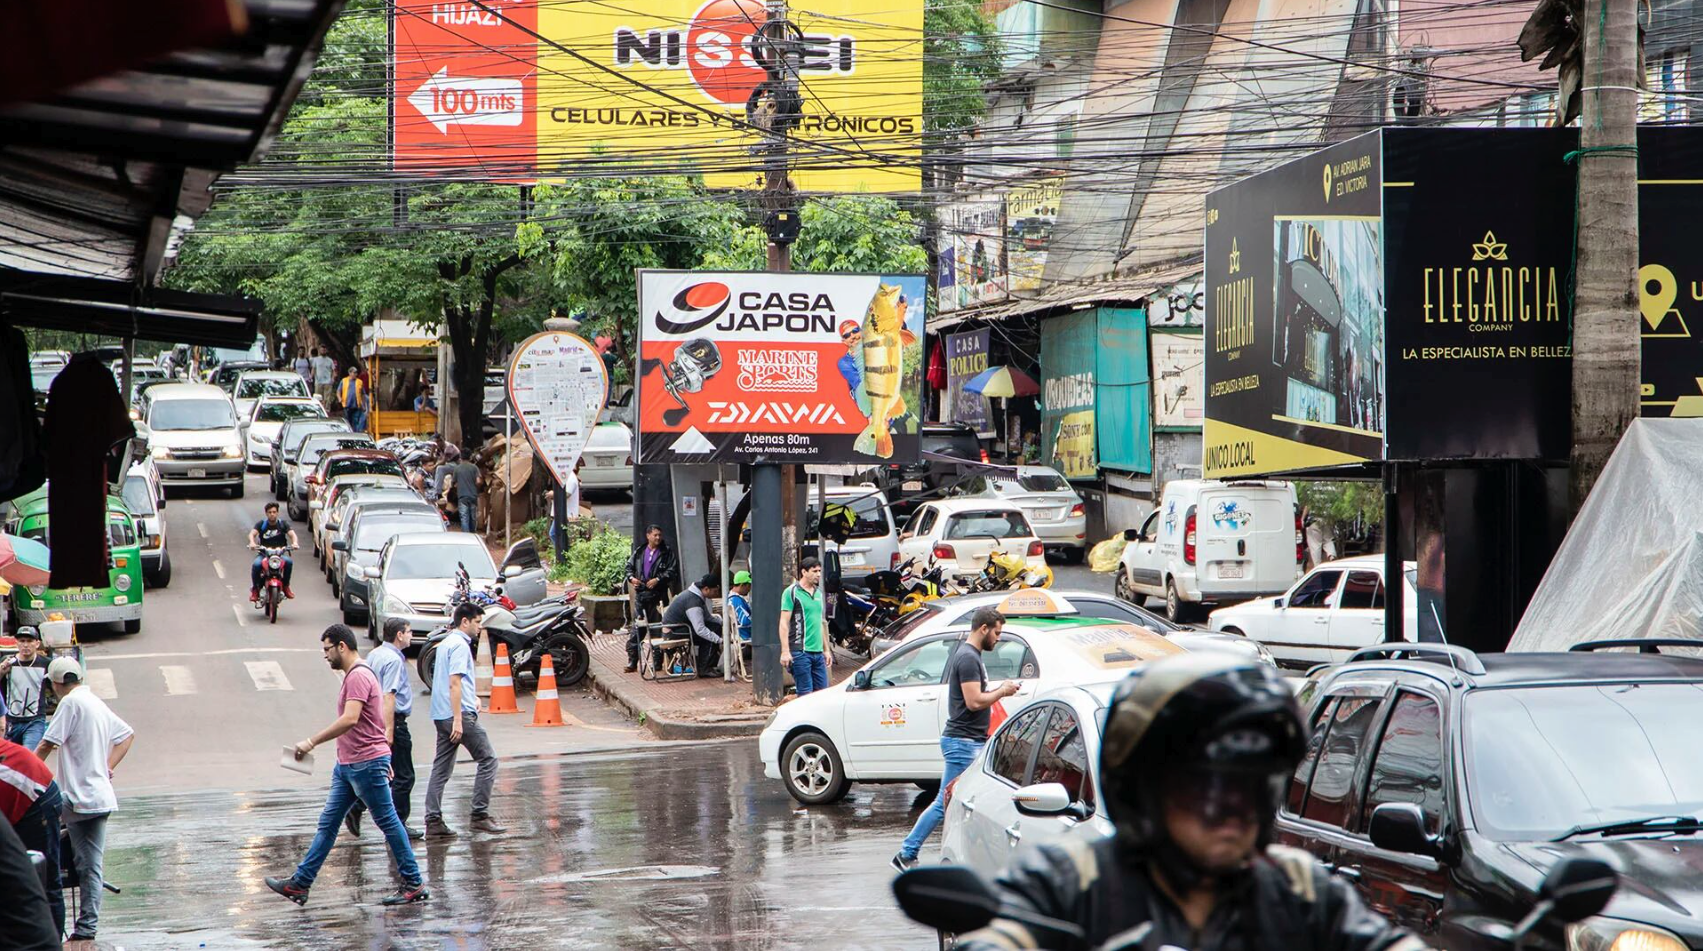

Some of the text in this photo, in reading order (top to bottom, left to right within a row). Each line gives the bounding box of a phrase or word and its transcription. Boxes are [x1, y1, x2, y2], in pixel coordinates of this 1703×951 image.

[432, 4, 502, 26] HIJAZI
[430, 87, 516, 115] 100 mts
[550, 107, 699, 127] CELULARES
[739, 292, 835, 311] CASA
[1423, 266, 1560, 323] ELEGANCIA
[716, 313, 836, 333] JAPON
[1468, 323, 1514, 332] COMPANY
[956, 335, 981, 353] CASA
[1402, 346, 1573, 360] LA ESPECIALISTA EN BELLEZ
[738, 350, 818, 365] MARINE
[950, 352, 988, 377] POLICE
[1045, 371, 1094, 411] ORQUIDEAS
[707, 402, 846, 424] DAIWA
[743, 433, 810, 445] Apenas 80m
[1230, 441, 1256, 468] LOCAL
[10, 687, 37, 716] ck
